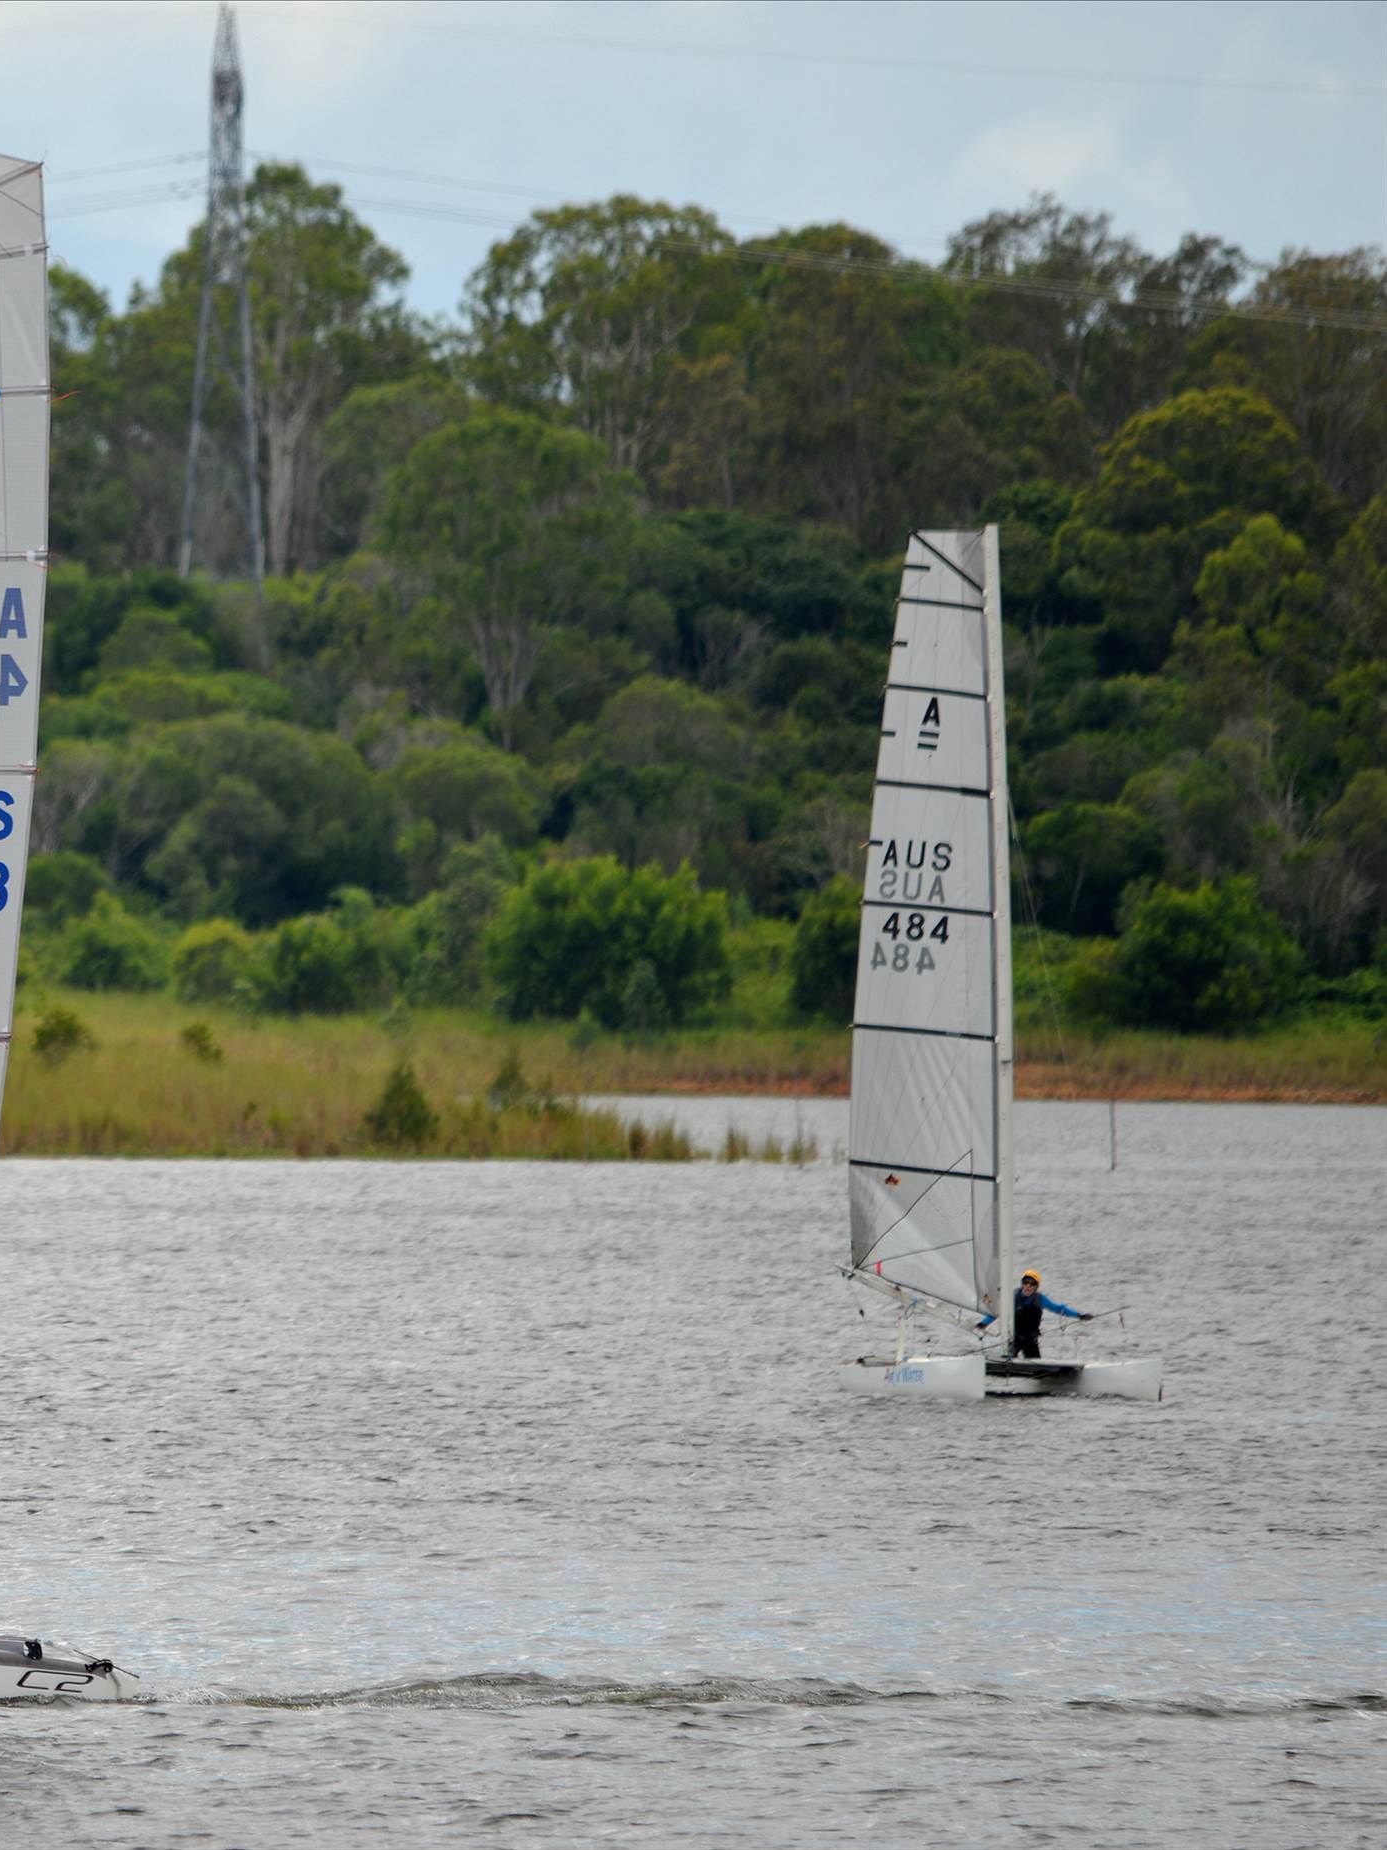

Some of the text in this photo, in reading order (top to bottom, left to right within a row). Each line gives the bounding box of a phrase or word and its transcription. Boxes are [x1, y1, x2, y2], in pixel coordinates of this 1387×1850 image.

[921, 696, 941, 727] A
[882, 839, 953, 872] AUS
[882, 911, 950, 945] 484
